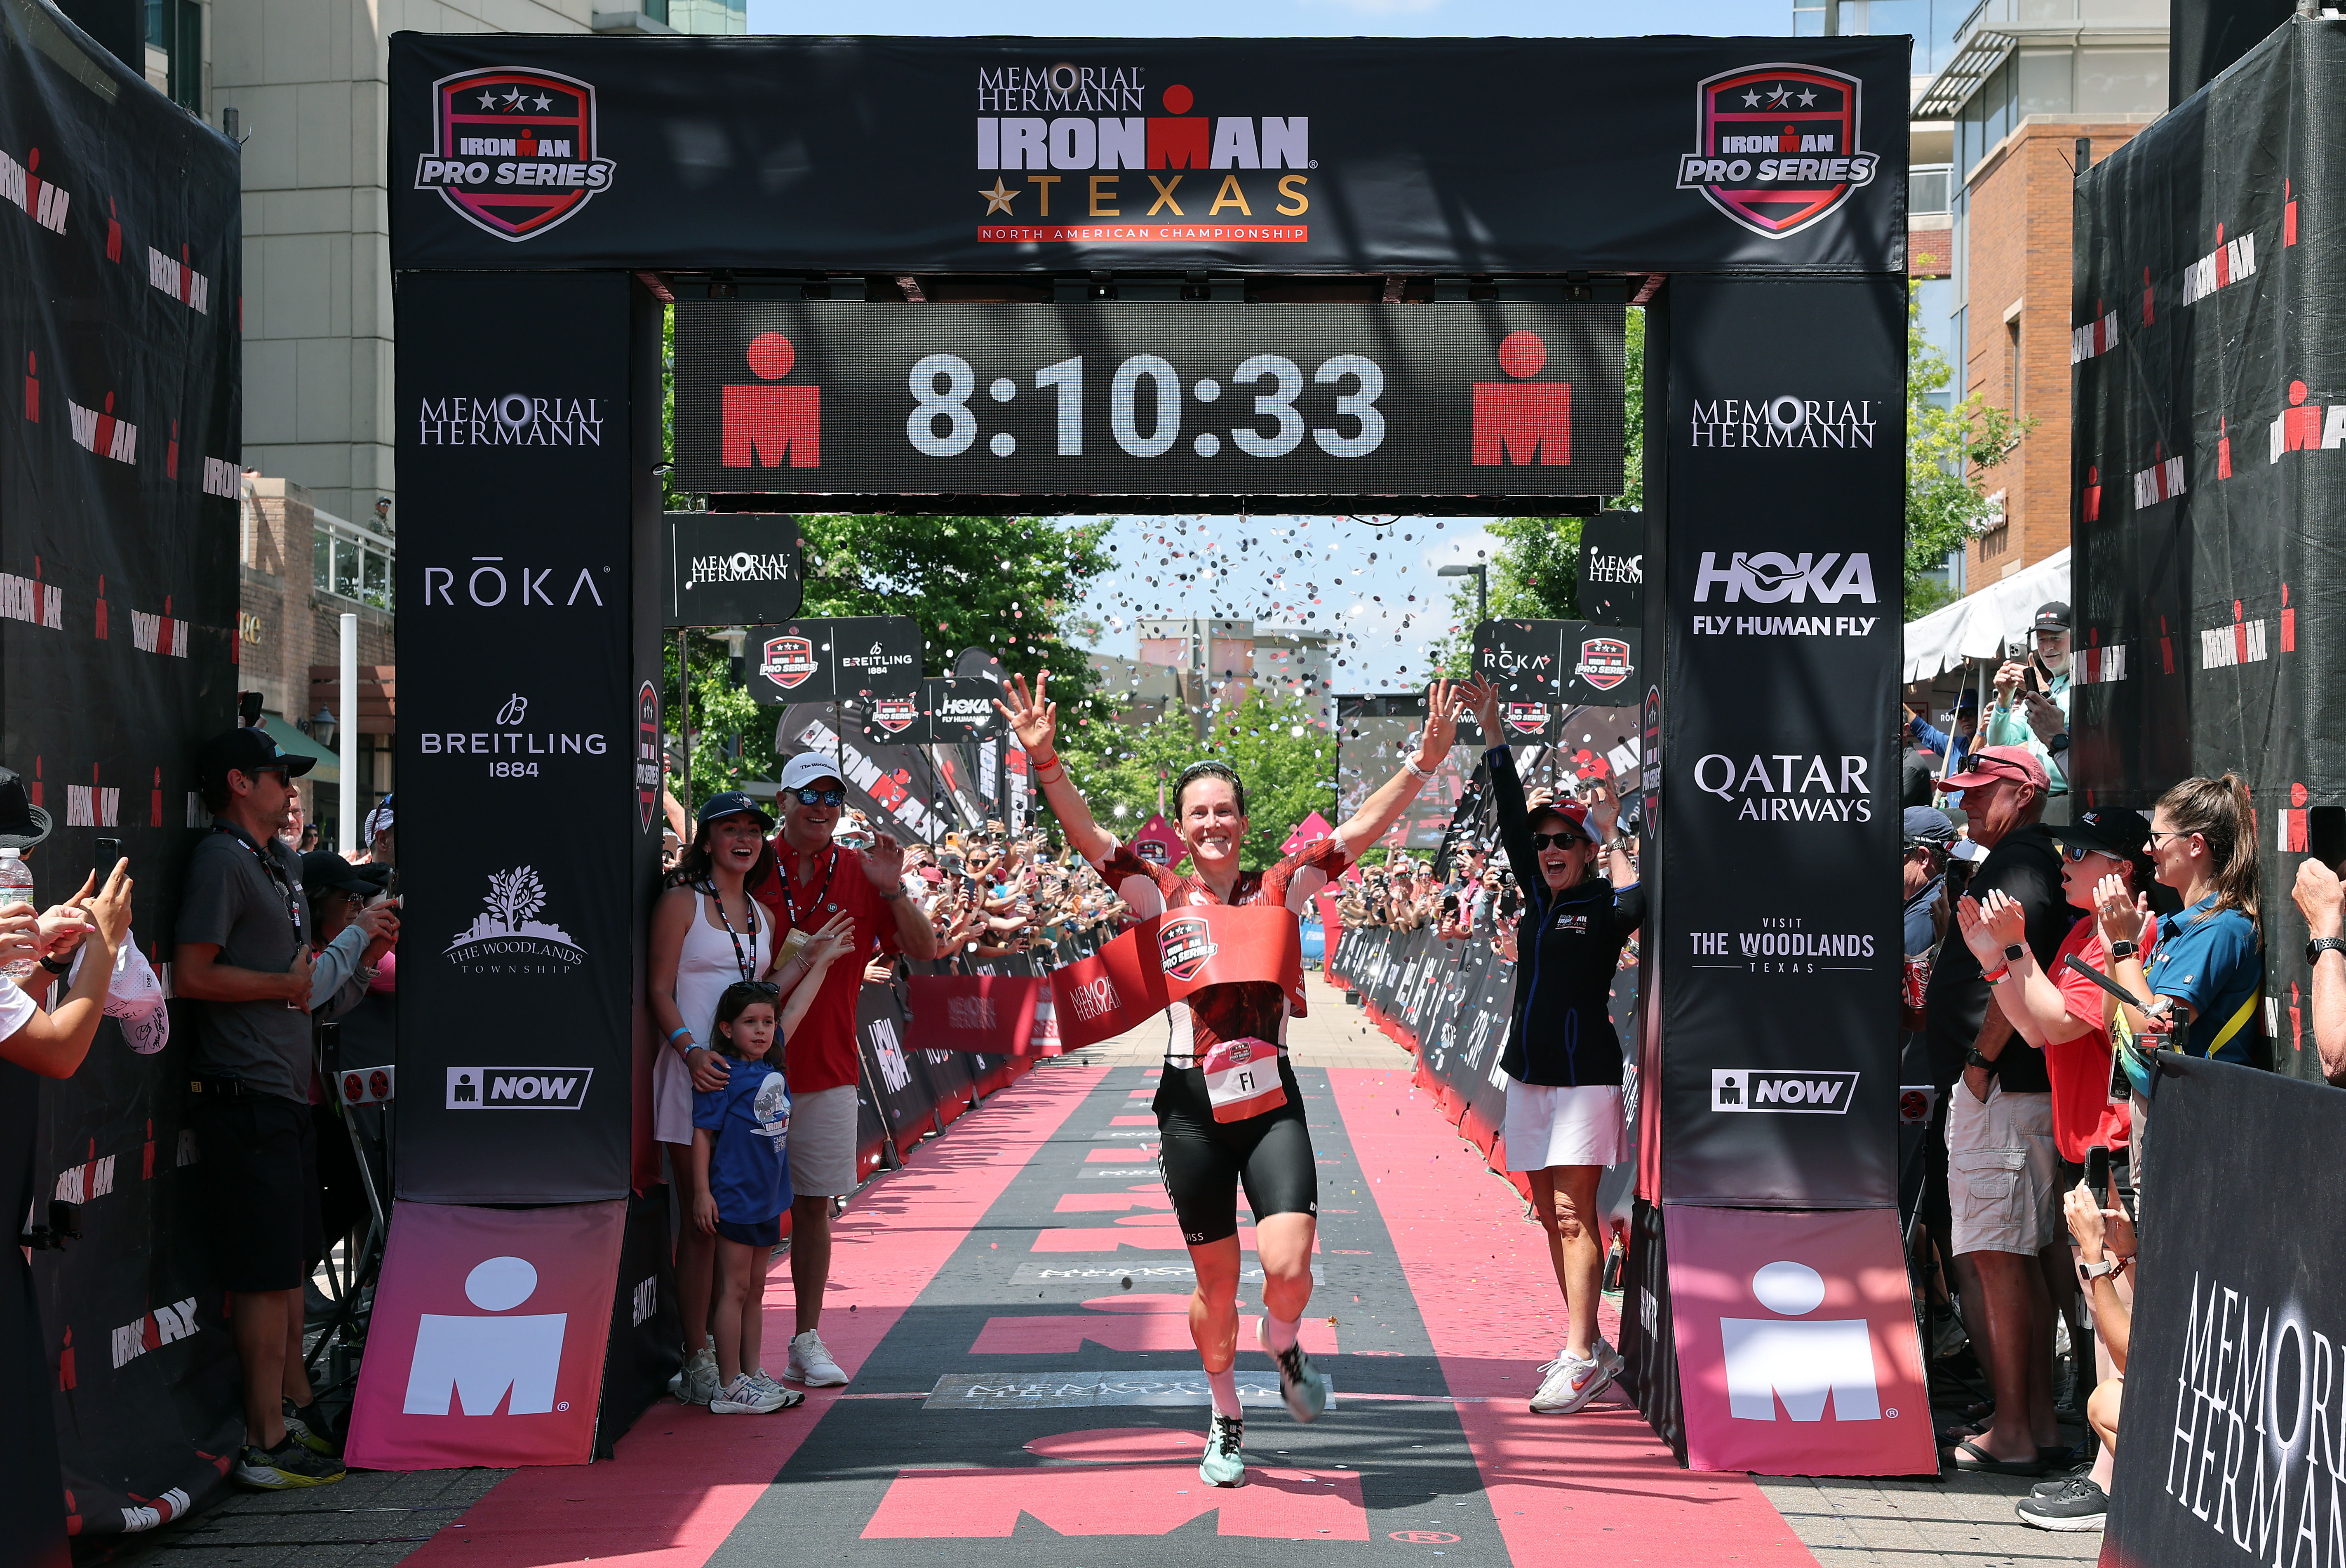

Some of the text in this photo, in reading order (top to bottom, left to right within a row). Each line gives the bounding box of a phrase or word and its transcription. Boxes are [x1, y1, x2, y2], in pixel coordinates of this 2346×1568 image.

[977, 66, 1145, 90] MEMORIAL
[978, 88, 1142, 111] HERMANN
[461, 138, 570, 157] IRONMAN
[978, 117, 1308, 169] IRONMAN
[1722, 135, 1833, 153] IRONMAN
[423, 161, 607, 186] PRO SERIES
[1684, 158, 1871, 182] PRO SERIES
[0, 149, 69, 235] RONMAN
[1027, 175, 1309, 216] TEXAS
[983, 228, 1304, 239] NORTH AMERICAN CHAMPIONSHIP
[149, 246, 208, 315] IRONMAN
[2183, 233, 2254, 307] IRONMAN
[419, 397, 603, 423] MEMORIAL
[907, 353, 1385, 457] 8:10:33
[1691, 399, 1877, 425] MEMORIAL
[419, 421, 602, 446] HERMANN
[1691, 423, 1873, 449] HERMANN
[691, 553, 788, 571] MEMORIAL
[1589, 555, 1642, 571] MEMO
[692, 567, 787, 583] HERMANN
[1589, 568, 1642, 584] HERM
[1694, 552, 1877, 603] HOKA
[1693, 616, 1877, 636] FLY HUMAN FLY
[2201, 619, 2266, 670] IRONMAN
[762, 663, 816, 673] PRO SERIES
[843, 655, 912, 667] BREITLING
[1577, 665, 1601, 674] PRO
[942, 698, 990, 715] HOKA
[1940, 712, 1955, 722] RŌK
[422, 733, 606, 755] BREITLING
[490, 762, 539, 777] 1884
[644, 764, 658, 785] SERIES
[1694, 754, 1871, 802] QATAR
[1738, 798, 1871, 822] AIRWAYS
[1763, 918, 1802, 929] VISIT
[447, 941, 583, 966] THE WOODLANDS
[1690, 932, 1875, 957] THE WOODLANDS
[462, 965, 571, 974] TOWNSHIP
[1162, 944, 1216, 971] PRO SERIES
[1750, 962, 1814, 974] TEXAS
[1069, 976, 1115, 1006] MEMOR
[491, 1077, 577, 1099] NOW
[1755, 1080, 1843, 1104] NOW
[633, 1274, 656, 1328] #IMTX
[2179, 1271, 2346, 1484] MEMOR
[2166, 1380, 2346, 1568] HERMA
